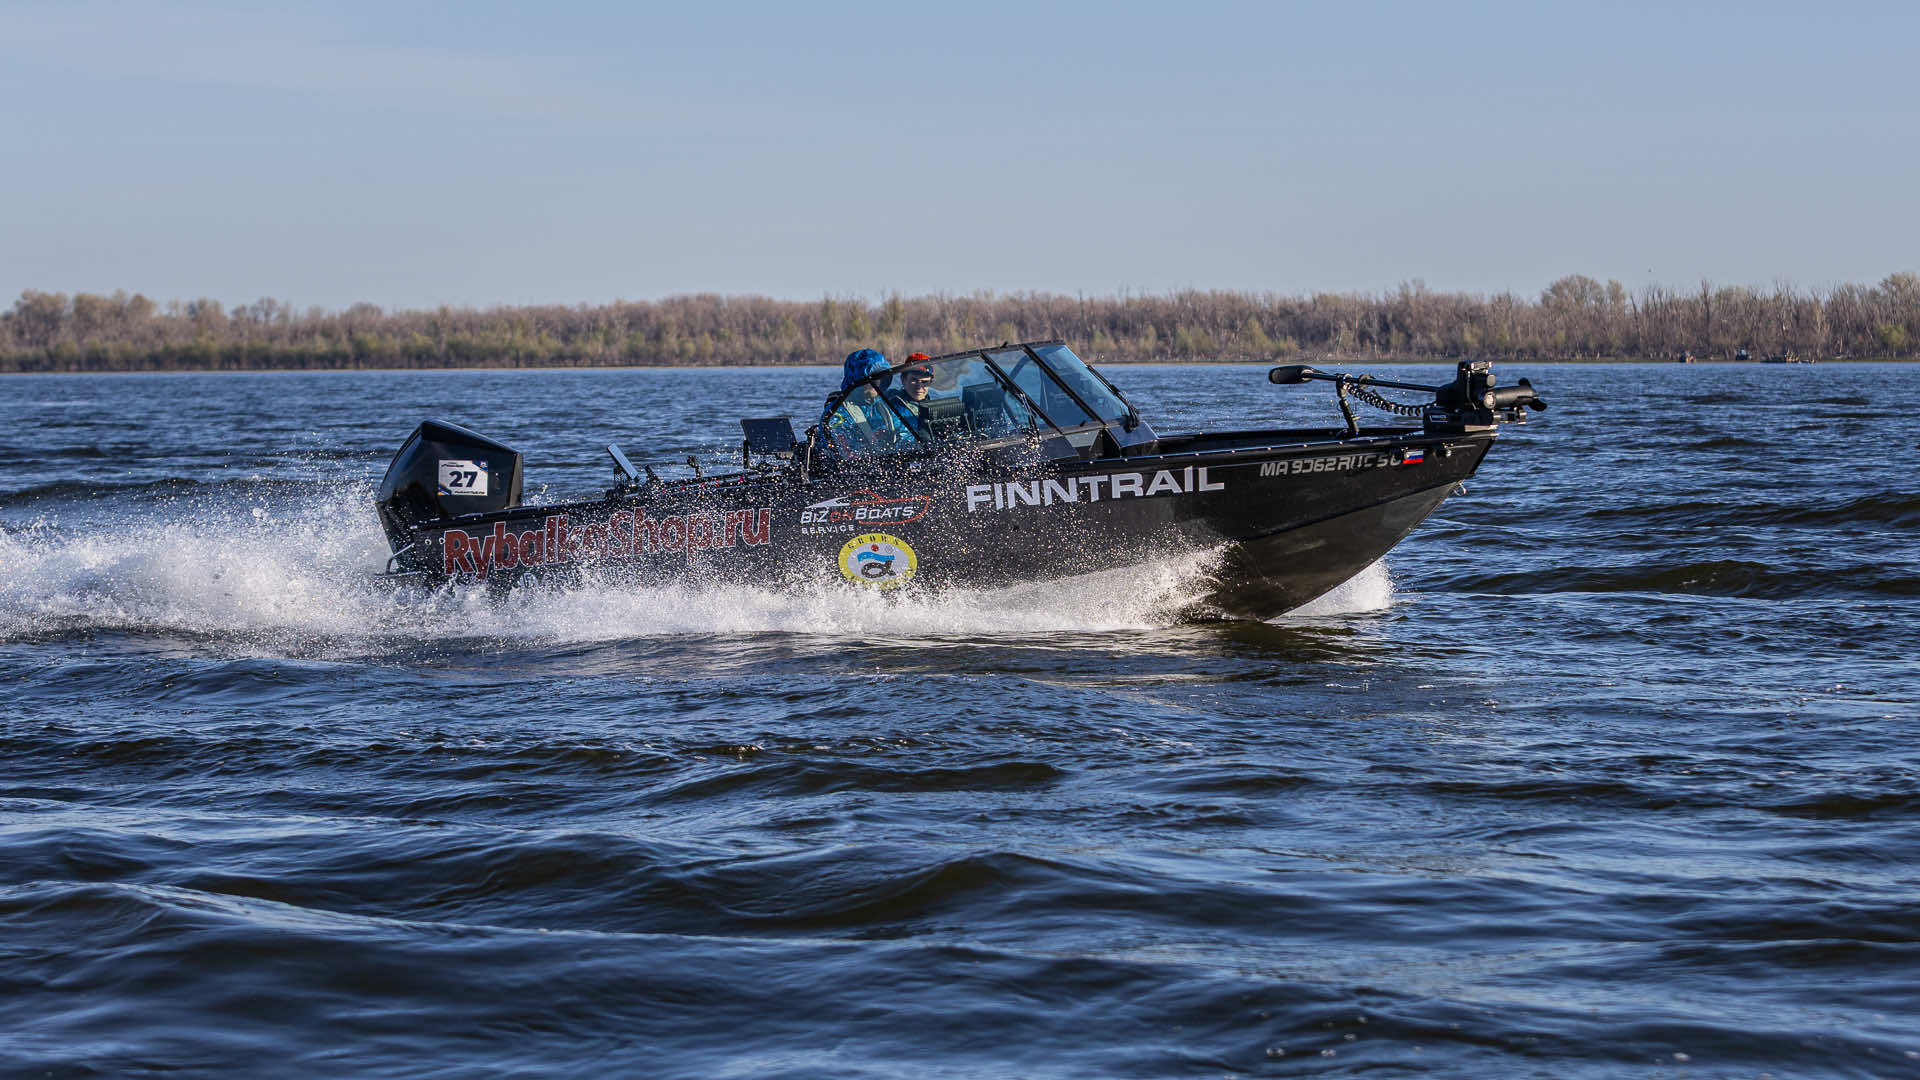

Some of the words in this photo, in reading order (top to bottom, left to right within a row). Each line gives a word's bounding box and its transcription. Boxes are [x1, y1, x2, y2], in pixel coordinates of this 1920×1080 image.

[449, 471, 478, 488] 27
[966, 465, 1225, 512] FINNTRAIL
[443, 507, 772, 579] RybalkaShop.ru
[801, 525, 855, 534] SERVICE
